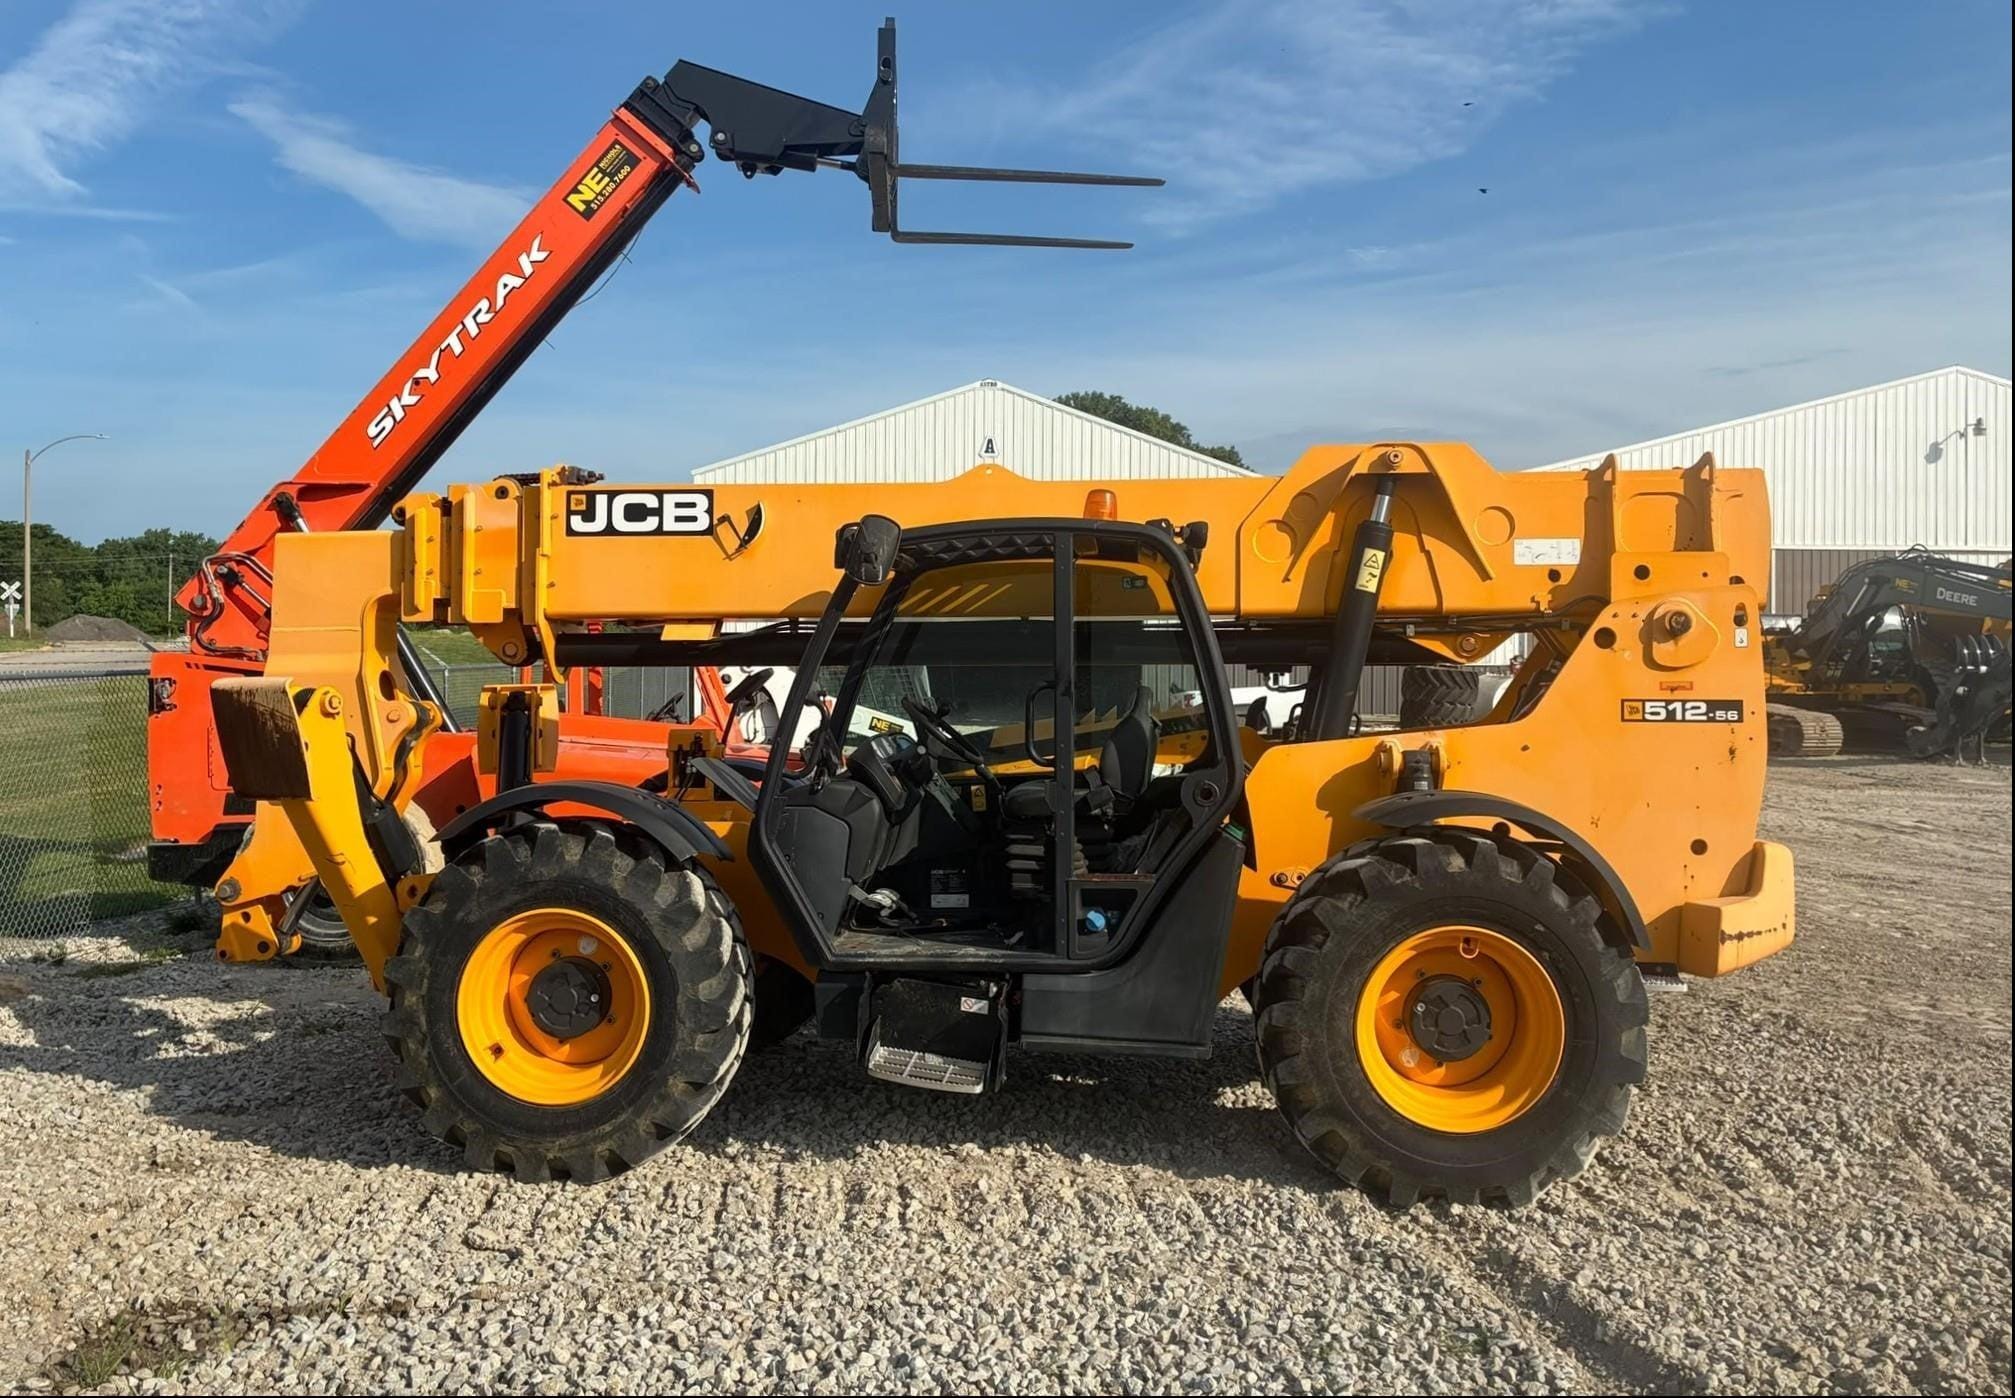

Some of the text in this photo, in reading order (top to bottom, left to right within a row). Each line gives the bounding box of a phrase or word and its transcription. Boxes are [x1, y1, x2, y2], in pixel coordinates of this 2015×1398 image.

[566, 166, 611, 212] NE
[366, 231, 552, 449] SKYTRAK
[984, 438, 996, 454] A
[569, 493, 710, 533] JCB
[1936, 587, 1978, 606] DEERE
[1643, 701, 1739, 721] 512-56
[871, 718, 889, 731] NE
